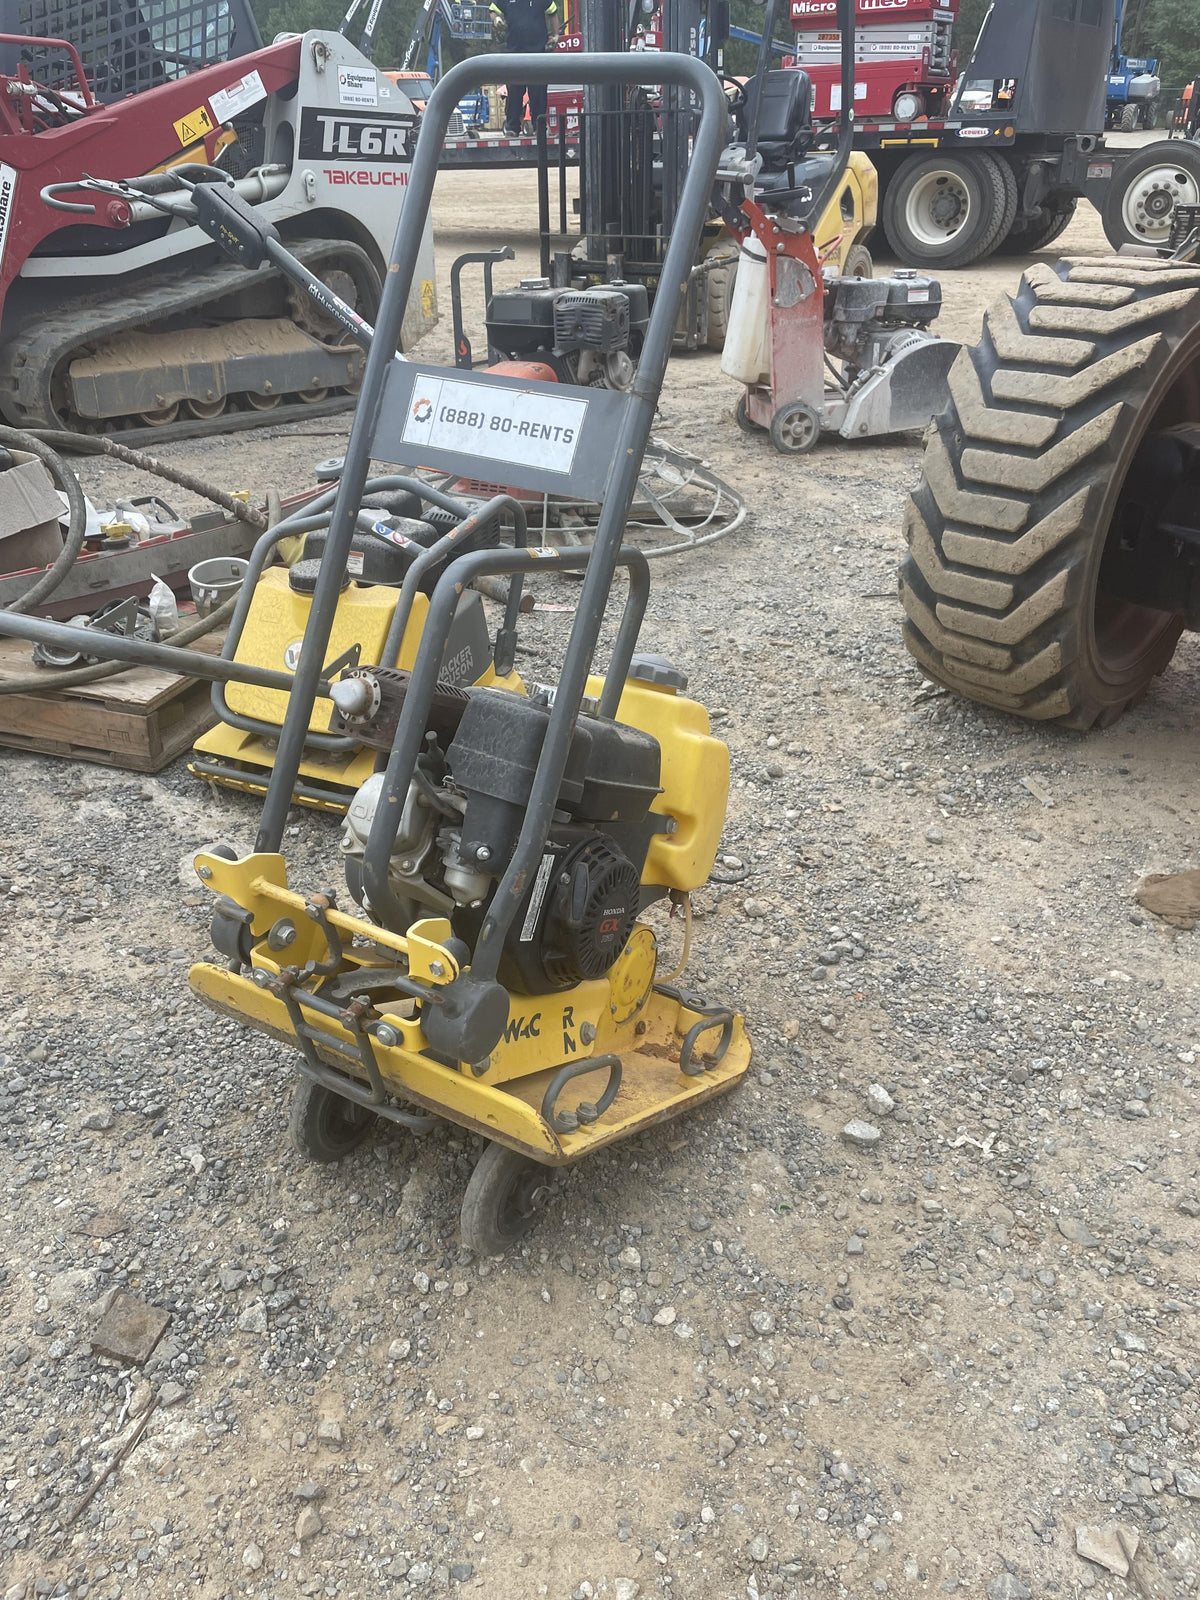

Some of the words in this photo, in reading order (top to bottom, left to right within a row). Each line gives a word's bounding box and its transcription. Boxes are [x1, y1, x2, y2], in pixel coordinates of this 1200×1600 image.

[792, 1, 837, 13] Micro
[346, 73, 376, 83] Equipment
[347, 80, 363, 88] Share
[317, 115, 413, 156] TL6R
[323, 169, 408, 185] TAKEUCHI
[439, 406, 485, 430] (888)
[489, 415, 575, 444] 80-RENTS
[603, 907, 625, 916] HONDA
[600, 917, 622, 934] GX
